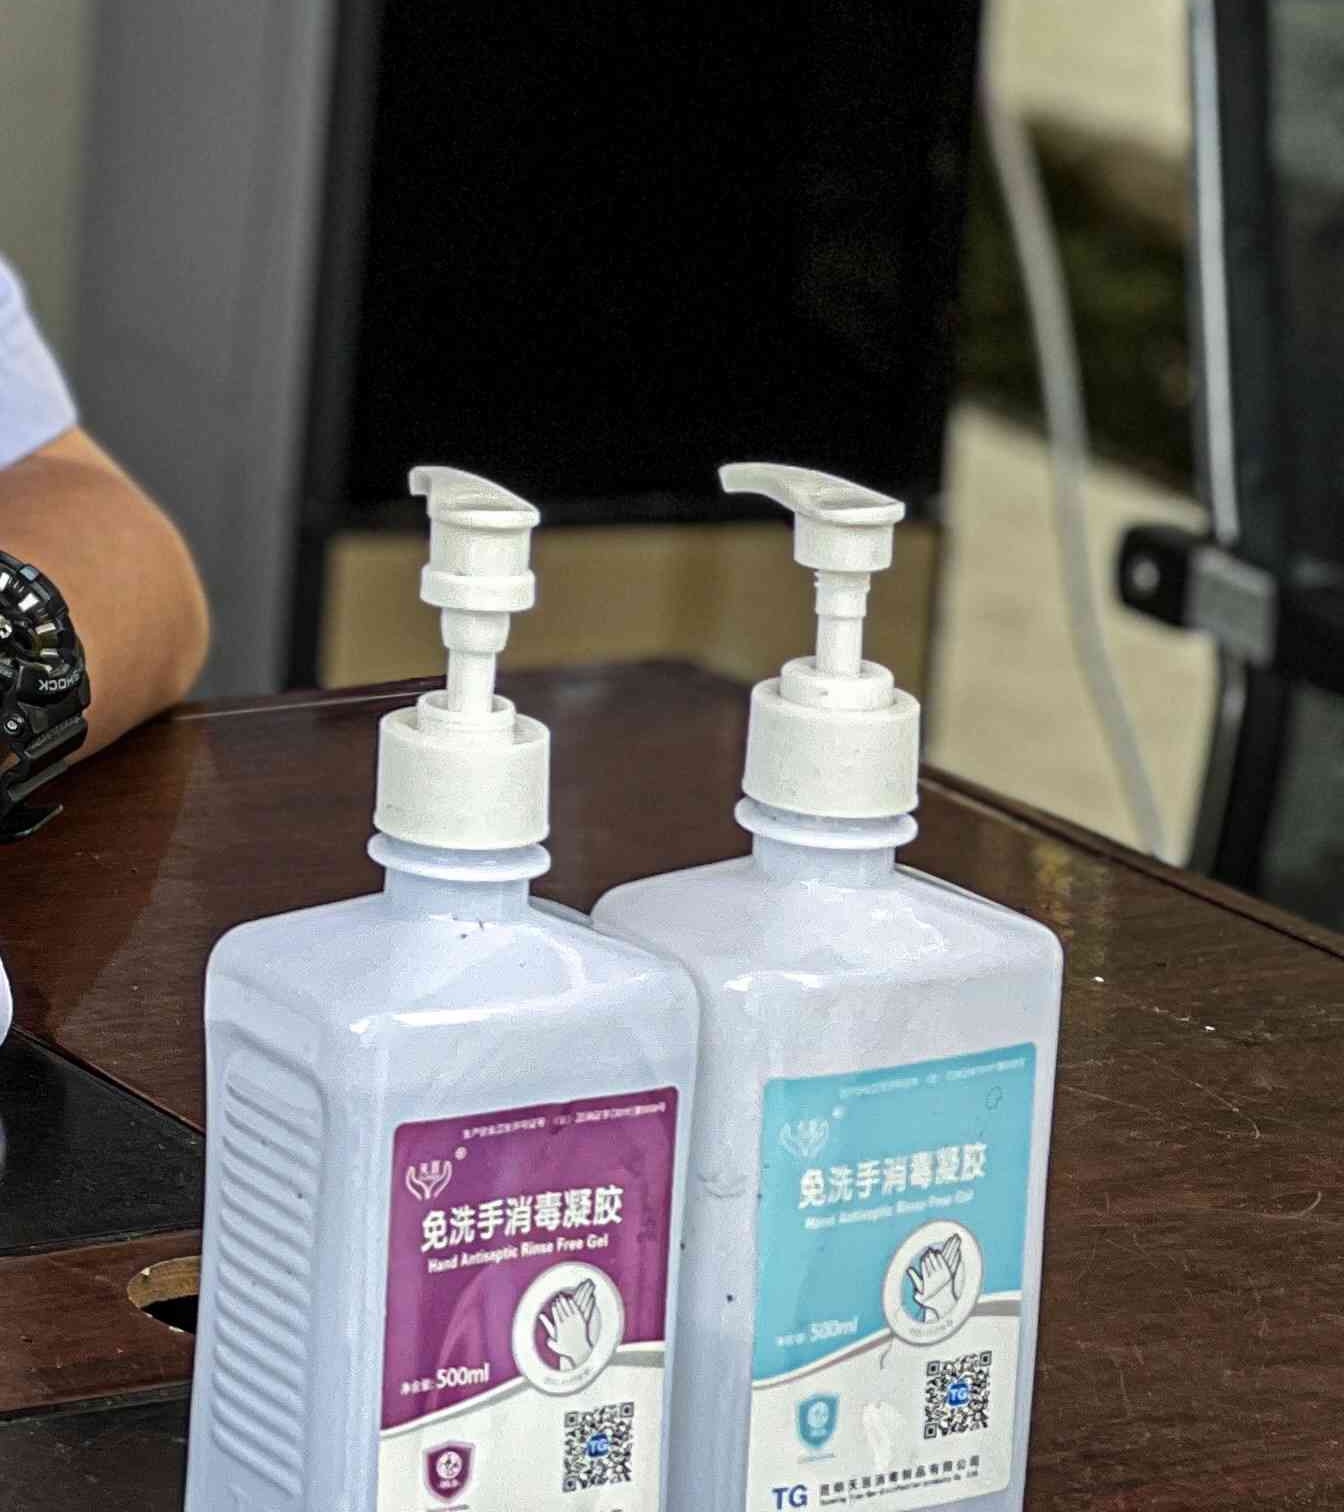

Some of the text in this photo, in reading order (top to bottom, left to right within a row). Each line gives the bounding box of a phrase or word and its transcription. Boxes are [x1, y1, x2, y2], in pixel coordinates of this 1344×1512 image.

[798, 1141, 987, 1209] 免洗手消毒凝胶
[421, 1185, 625, 1253] 免洗手消毒凝胶
[427, 1233, 609, 1273] Hand Antiseptic Rinse Free Gel
[436, 1362, 490, 1389] 500ml
[772, 1484, 808, 1510] TG
